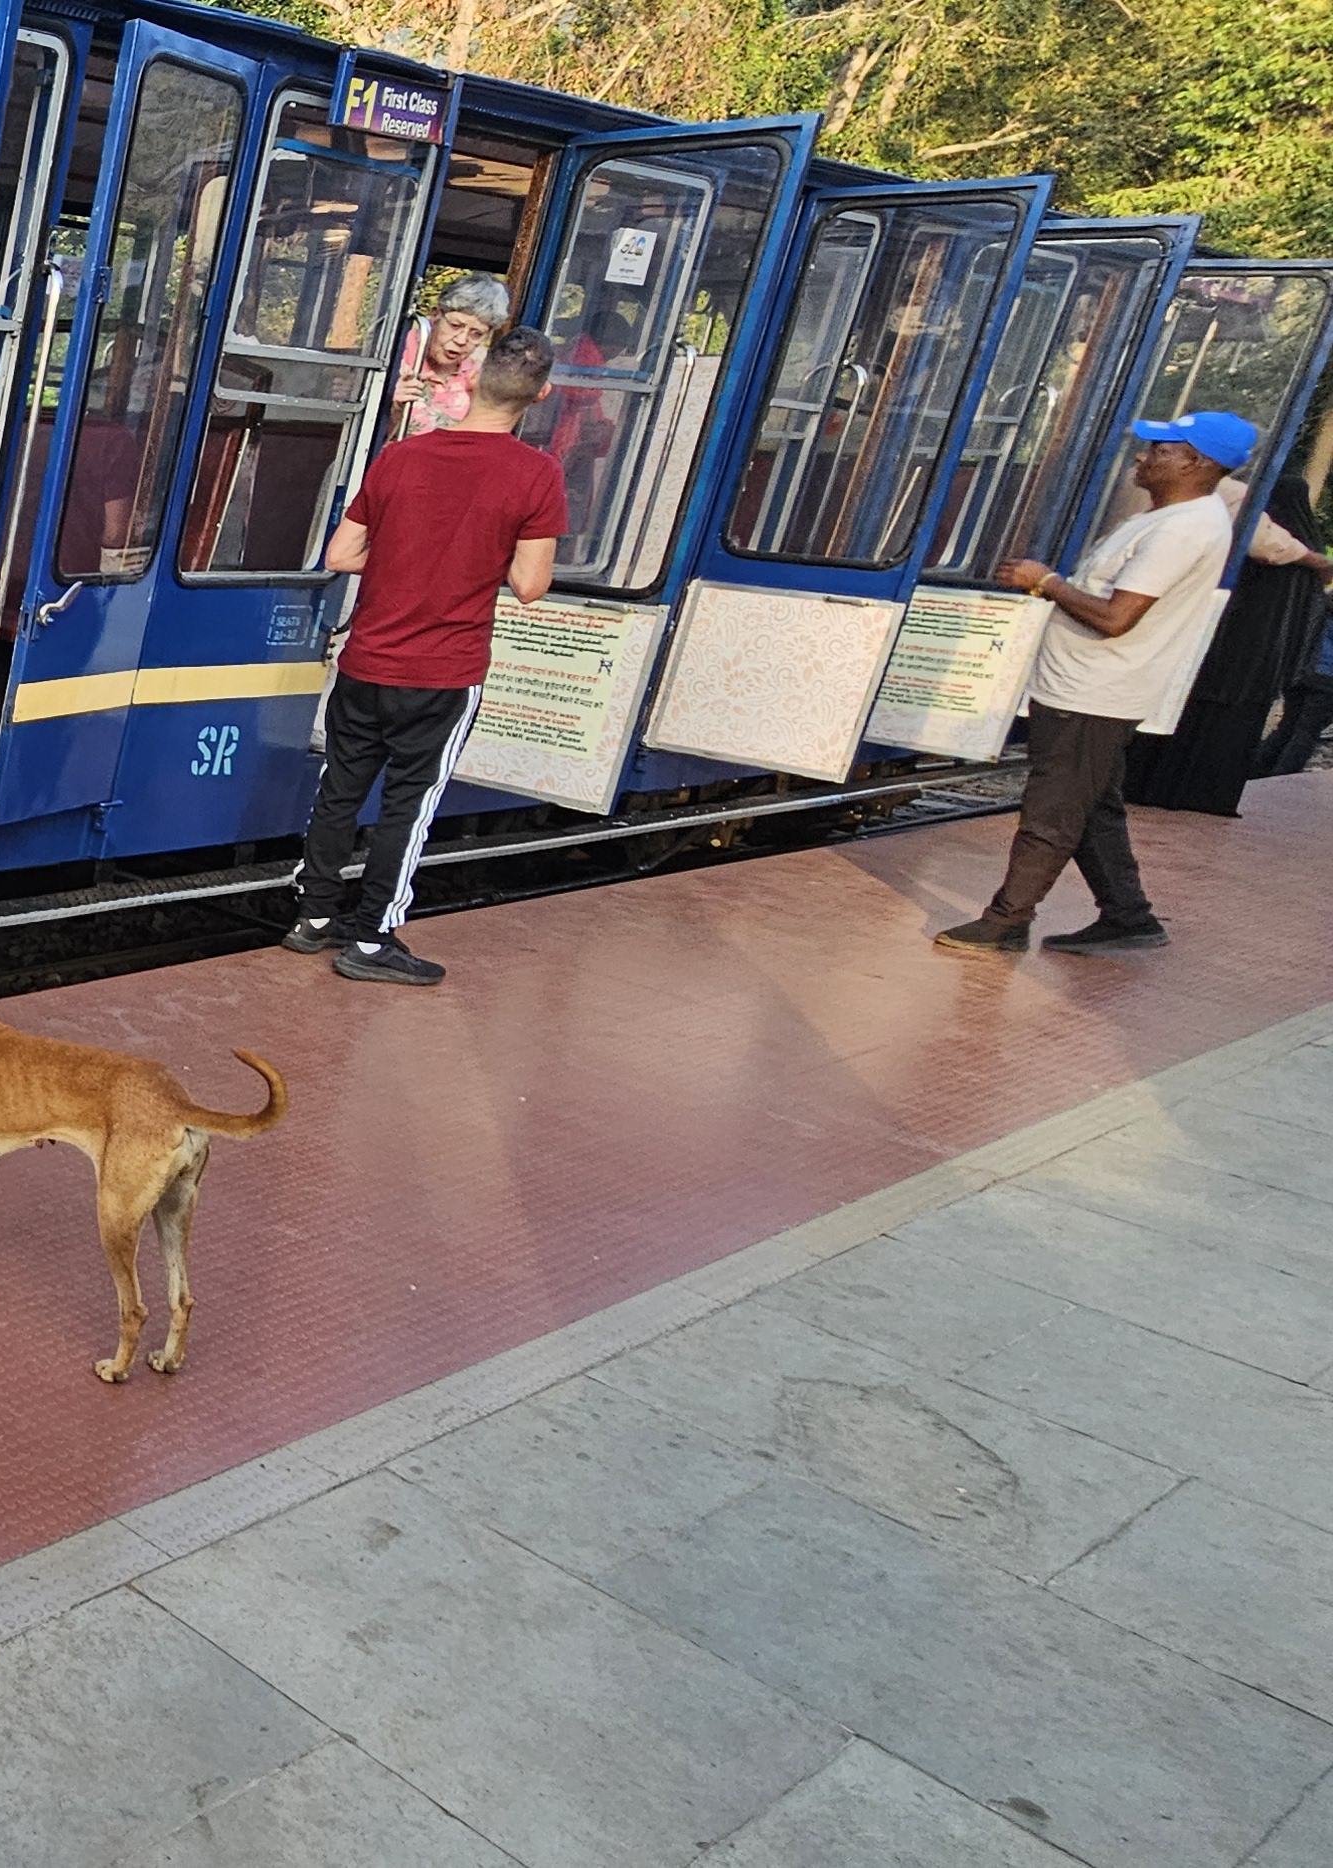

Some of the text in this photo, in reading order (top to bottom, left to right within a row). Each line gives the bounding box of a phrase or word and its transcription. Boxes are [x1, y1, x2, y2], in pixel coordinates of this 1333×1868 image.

[343, 77, 379, 129] F1
[381, 86, 438, 116] First Class
[380, 112, 432, 139] Reserved
[276, 616, 301, 627] SEATS
[191, 725, 240, 776] SR
